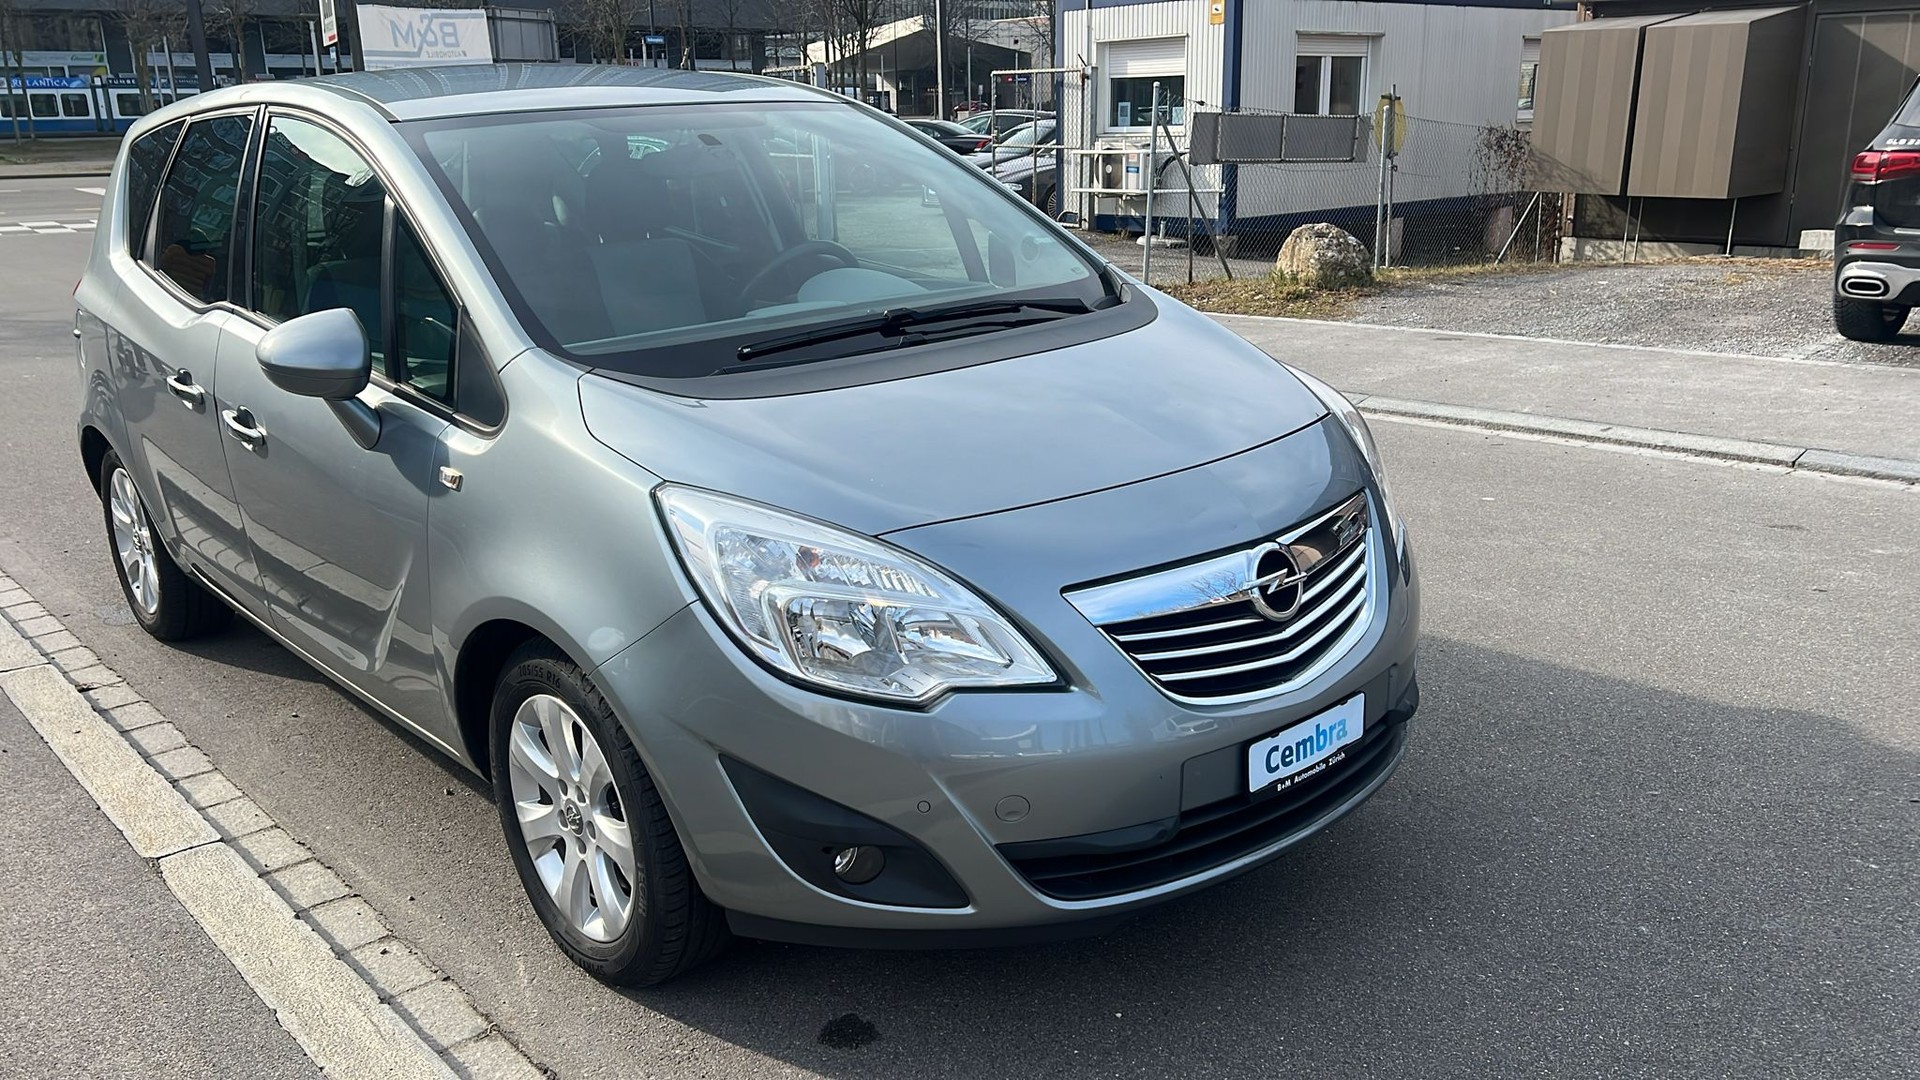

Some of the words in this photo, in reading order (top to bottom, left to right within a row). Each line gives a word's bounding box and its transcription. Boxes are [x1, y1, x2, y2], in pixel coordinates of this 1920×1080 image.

[1265, 719, 1348, 774] Cembra
[1277, 779, 1292, 792] B+M
[1294, 762, 1327, 784] Automobile
[1328, 751, 1346, 766] Zürich
